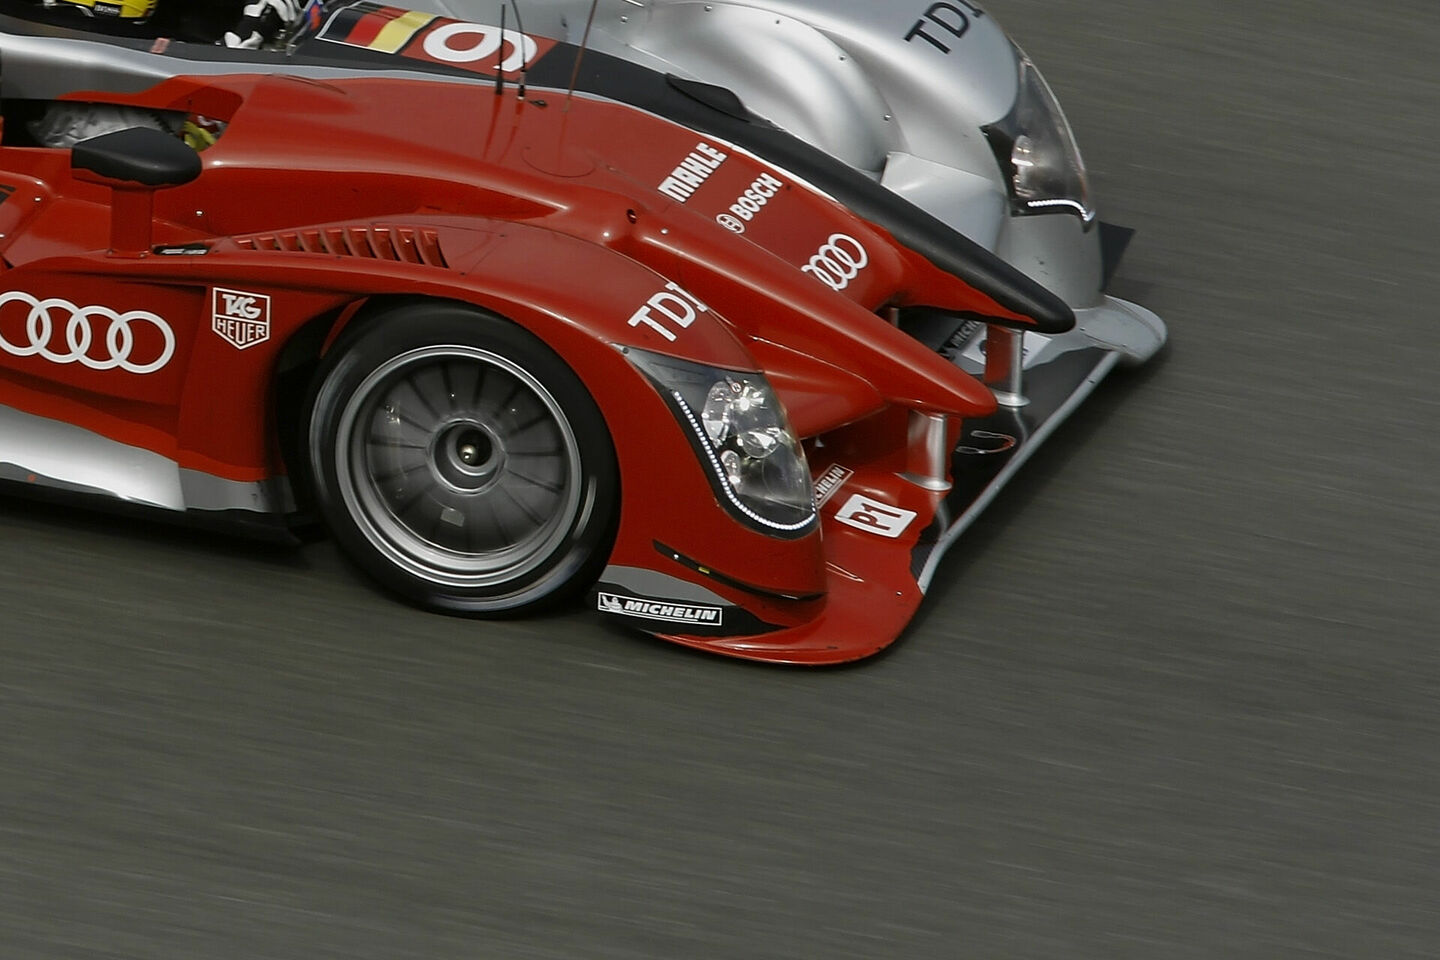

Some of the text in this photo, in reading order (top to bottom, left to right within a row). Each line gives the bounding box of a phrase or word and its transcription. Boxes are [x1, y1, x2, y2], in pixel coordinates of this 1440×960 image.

[422, 22, 538, 72] 9
[657, 142, 728, 204] MAHLE
[729, 172, 783, 222] BOSCH
[222, 293, 262, 320] TAG
[627, 282, 708, 342] TDI
[216, 318, 266, 344] HEUER
[849, 502, 902, 531] P1
[624, 600, 718, 621] MICHELIN
